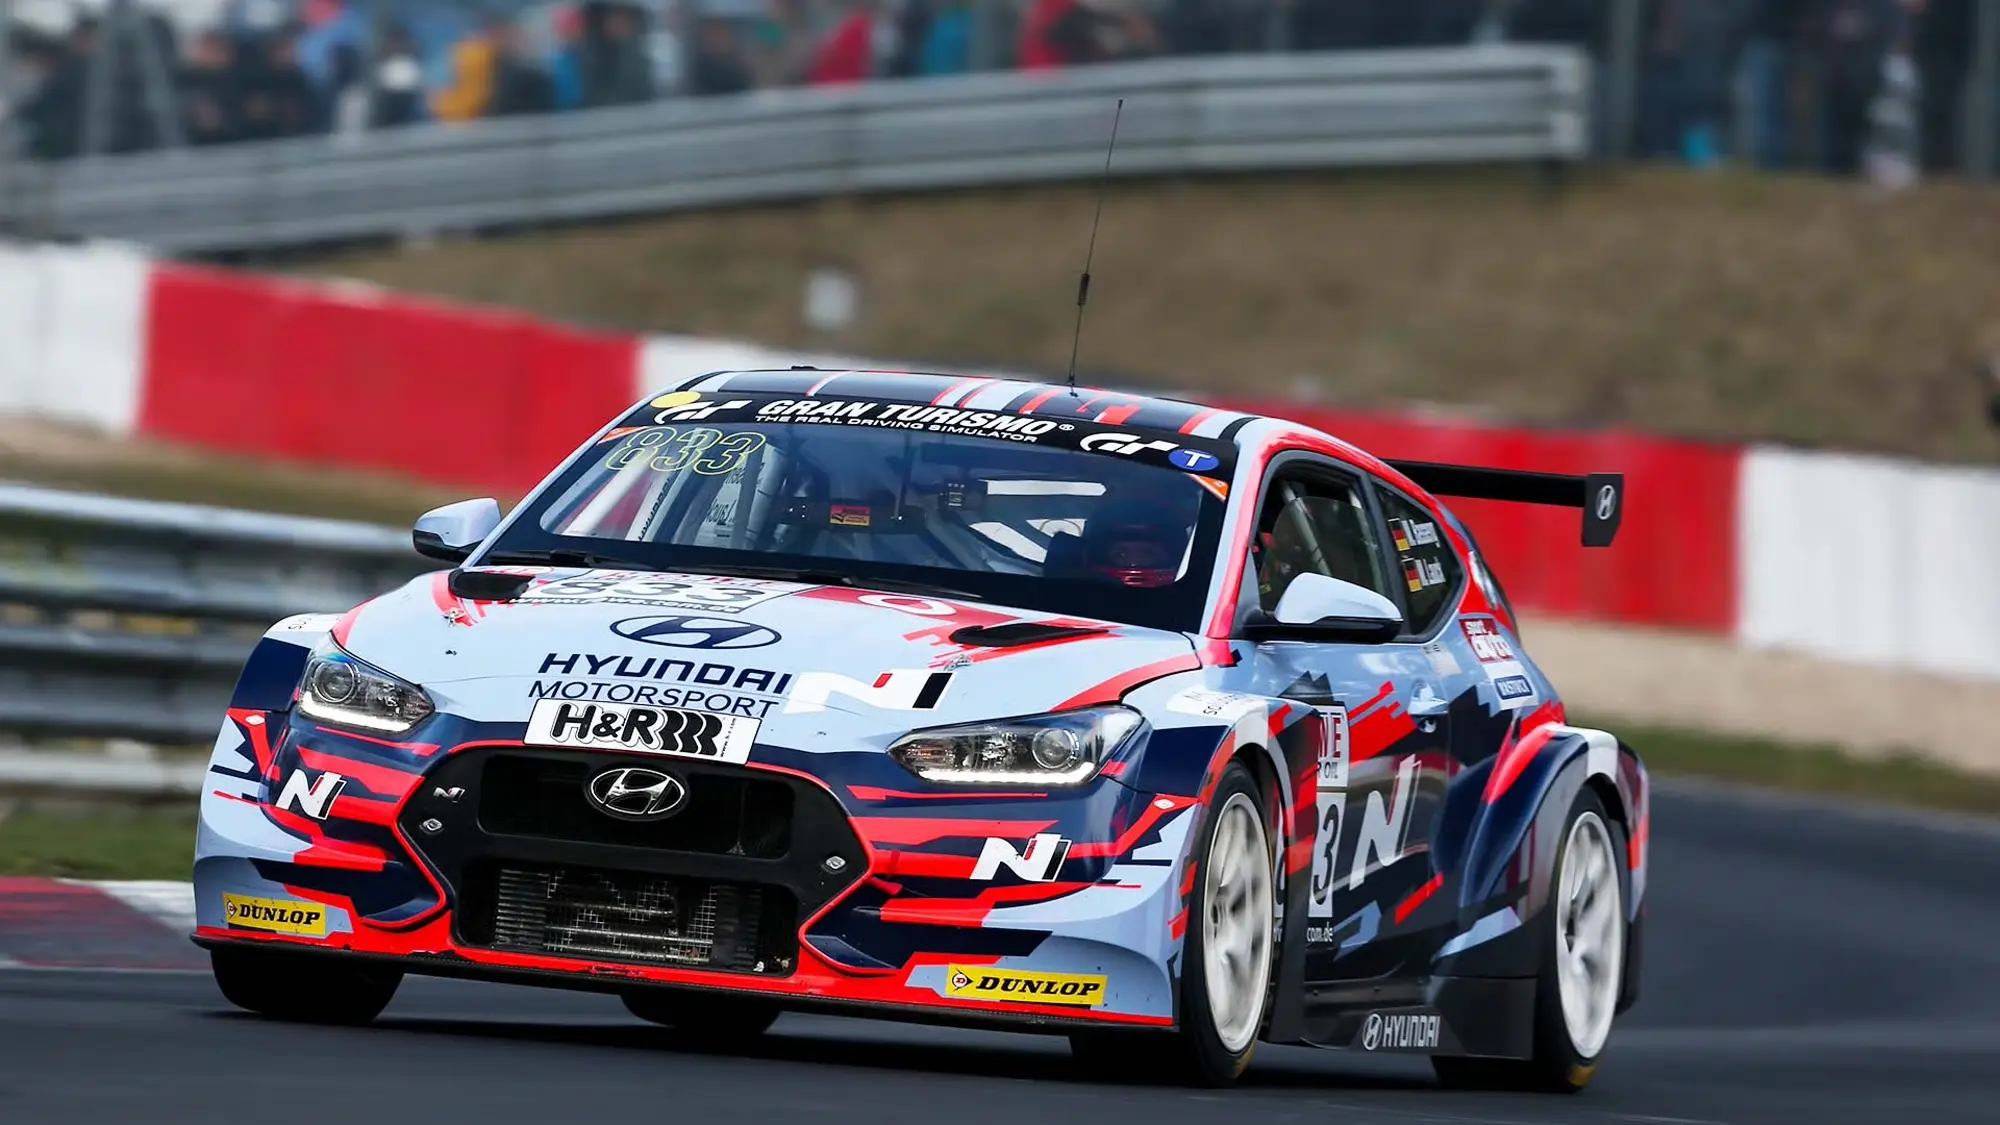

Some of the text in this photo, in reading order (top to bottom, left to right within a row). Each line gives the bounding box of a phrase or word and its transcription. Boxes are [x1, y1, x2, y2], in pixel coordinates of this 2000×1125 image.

[757, 399, 878, 418] GRAN
[754, 415, 1038, 443] THE REAL DRIVING SIMULATOR
[605, 426, 767, 476] 833
[540, 581, 766, 602] 833
[537, 652, 793, 694] HYUNDAI
[528, 679, 780, 718] MOTORSPORT
[239, 903, 321, 925] DUNLOP
[975, 976, 1101, 996] DUNLOP
[1382, 1015, 1441, 1048] HYUNDAI
